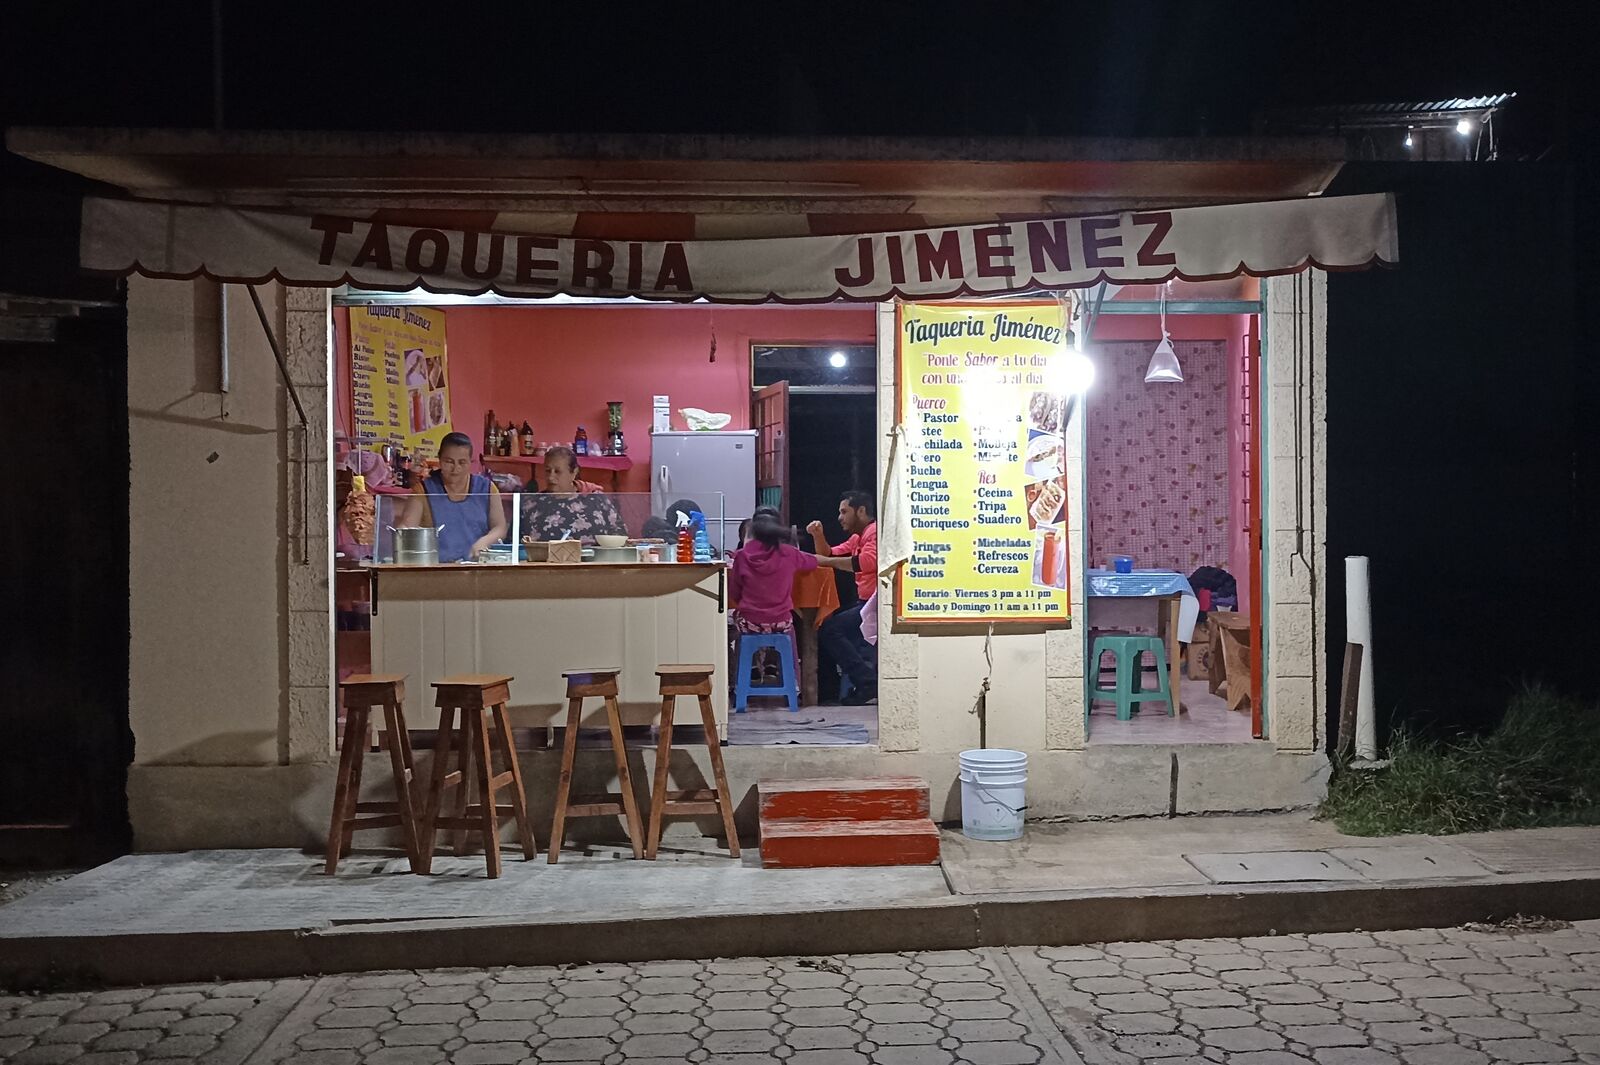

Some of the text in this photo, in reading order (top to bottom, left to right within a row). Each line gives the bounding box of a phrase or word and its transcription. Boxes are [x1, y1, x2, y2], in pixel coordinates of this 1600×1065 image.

[310, 211, 1177, 292] TAQUERIA JIMENEZ
[905, 314, 1061, 346] Taqueria Jiménez
[1003, 357, 1009, 366] a
[922, 374, 942, 384] con
[924, 413, 958, 422] Pastor
[911, 452, 941, 462] Cero
[910, 466, 941, 475] Buche
[978, 471, 996, 484] Res
[911, 479, 948, 491] Lengua
[910, 492, 950, 502] Chorizo
[978, 488, 1013, 497] Cecina
[910, 505, 950, 515] Mixiote
[978, 501, 1006, 513] Tripa
[911, 518, 969, 530] Choriqueso
[978, 514, 1021, 524] Suadero
[978, 539, 1031, 548] Micheladas
[910, 555, 945, 565] Arabes
[978, 551, 1028, 560] Refrescos
[910, 568, 944, 578] Suizos
[978, 564, 1018, 573] Cerveza
[914, 589, 951, 598] Horario:
[955, 590, 988, 598] Viernes
[992, 590, 997, 598] 3
[1000, 591, 1013, 600] pm
[1026, 590, 1034, 598] 11
[1038, 591, 1051, 600] pm
[908, 603, 940, 611] Sabado
[943, 604, 948, 613] y
[951, 603, 990, 613] Domingo
[994, 603, 1004, 611] 11
[1032, 603, 1042, 611] 11
[1045, 604, 1058, 613] pm
